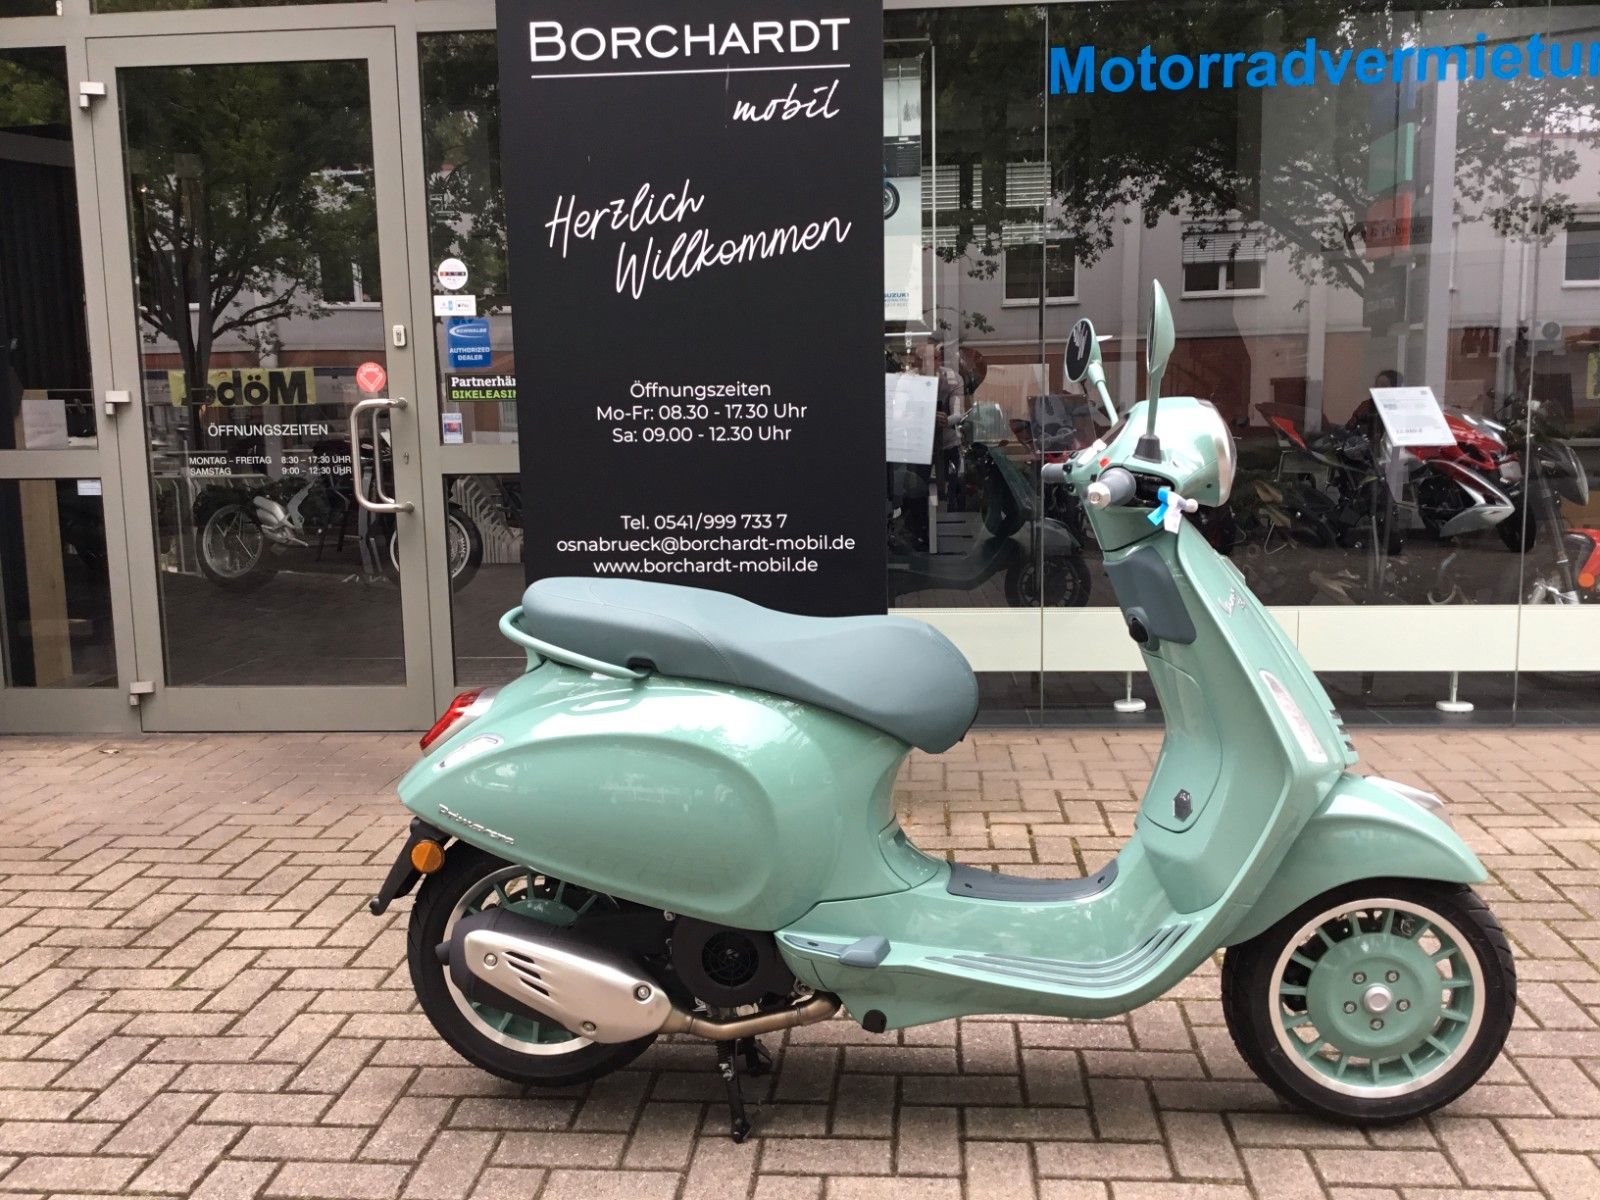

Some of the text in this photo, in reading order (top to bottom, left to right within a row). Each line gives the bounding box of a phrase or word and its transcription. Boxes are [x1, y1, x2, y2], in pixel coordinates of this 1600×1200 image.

[733, 79, 839, 121] mobil
[545, 178, 705, 258] Herzlich
[615, 217, 852, 299] Willkommen
[630, 380, 770, 400] Öffnungszeiten
[597, 406, 653, 420] Mo-Fr:
[659, 405, 708, 420] 08.30
[725, 404, 768, 418] 17.30
[774, 403, 807, 418] Uhr
[207, 423, 329, 437] ÖFFNUNGSZEITEN
[613, 428, 637, 442] Sa:
[643, 427, 692, 442] 09.00
[709, 426, 752, 441] 12.30
[759, 425, 791, 440] Uhr
[189, 457, 226, 465] MONTAG
[235, 456, 272, 464] FREITAG
[281, 456, 298, 464] 8:30
[308, 456, 330, 464] 17:30
[332, 455, 351, 464] UHR
[190, 467, 232, 476] SAMSTAG
[282, 467, 299, 475] 9:00
[308, 466, 331, 475] 12:30
[333, 466, 352, 475] UHR
[621, 513, 787, 530] Tel. 0541/999 733 7
[557, 535, 855, 554] osnabrueck@borchardt-mobil.de
[594, 557, 818, 572] www.borchardt-mobil.de
